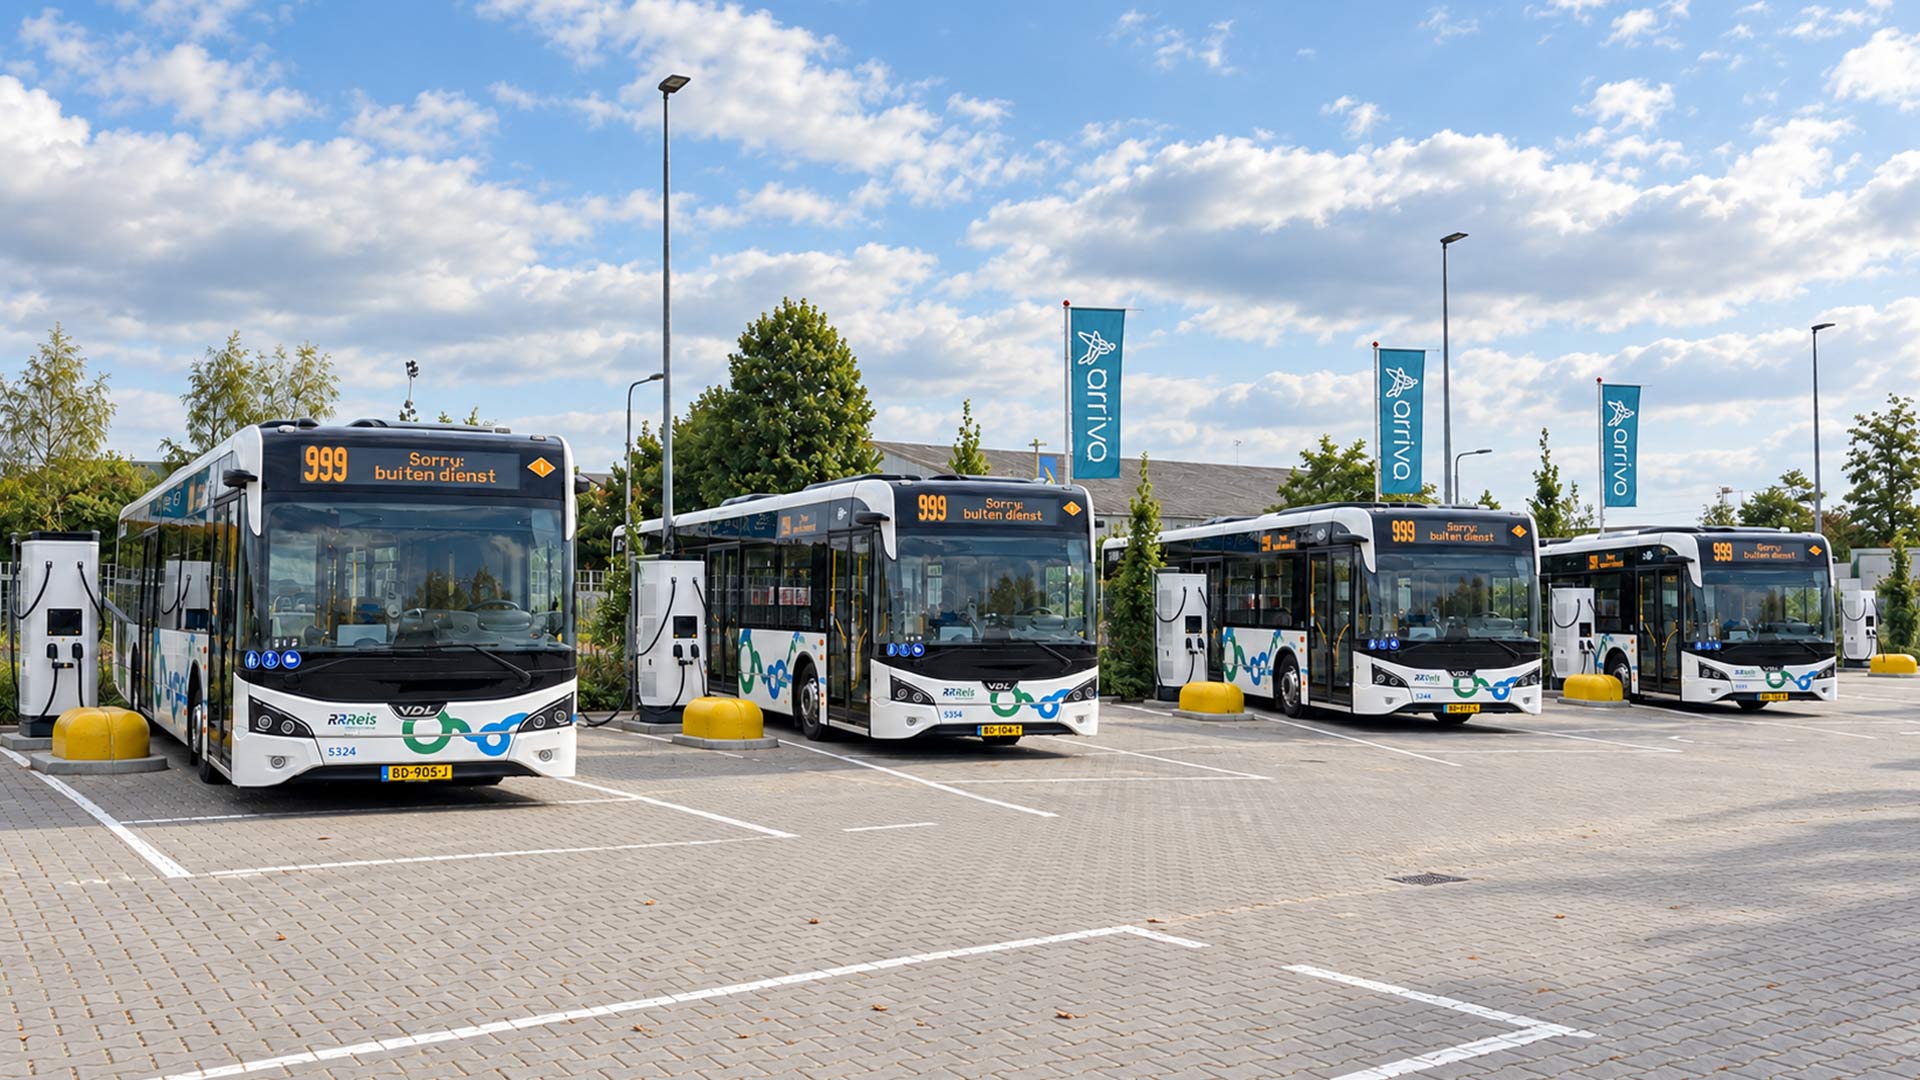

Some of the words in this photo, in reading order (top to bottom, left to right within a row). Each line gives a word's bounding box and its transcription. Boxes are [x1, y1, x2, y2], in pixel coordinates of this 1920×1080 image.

[1087, 368, 1112, 463] arriva
[1393, 400, 1415, 480] arriva
[304, 445, 348, 483] 999
[409, 451, 465, 468] Sorry:
[374, 465, 435, 482] buiten
[439, 467, 497, 484] dienst
[918, 494, 948, 522] 999
[1391, 519, 1416, 543] 999
[1713, 542, 1733, 562] 999
[987, 682, 1011, 690] VDL
[327, 712, 377, 726] RRReis
[399, 705, 436, 716] VDL
[328, 746, 357, 757] 5324
[391, 766, 449, 779] BD-905-J
